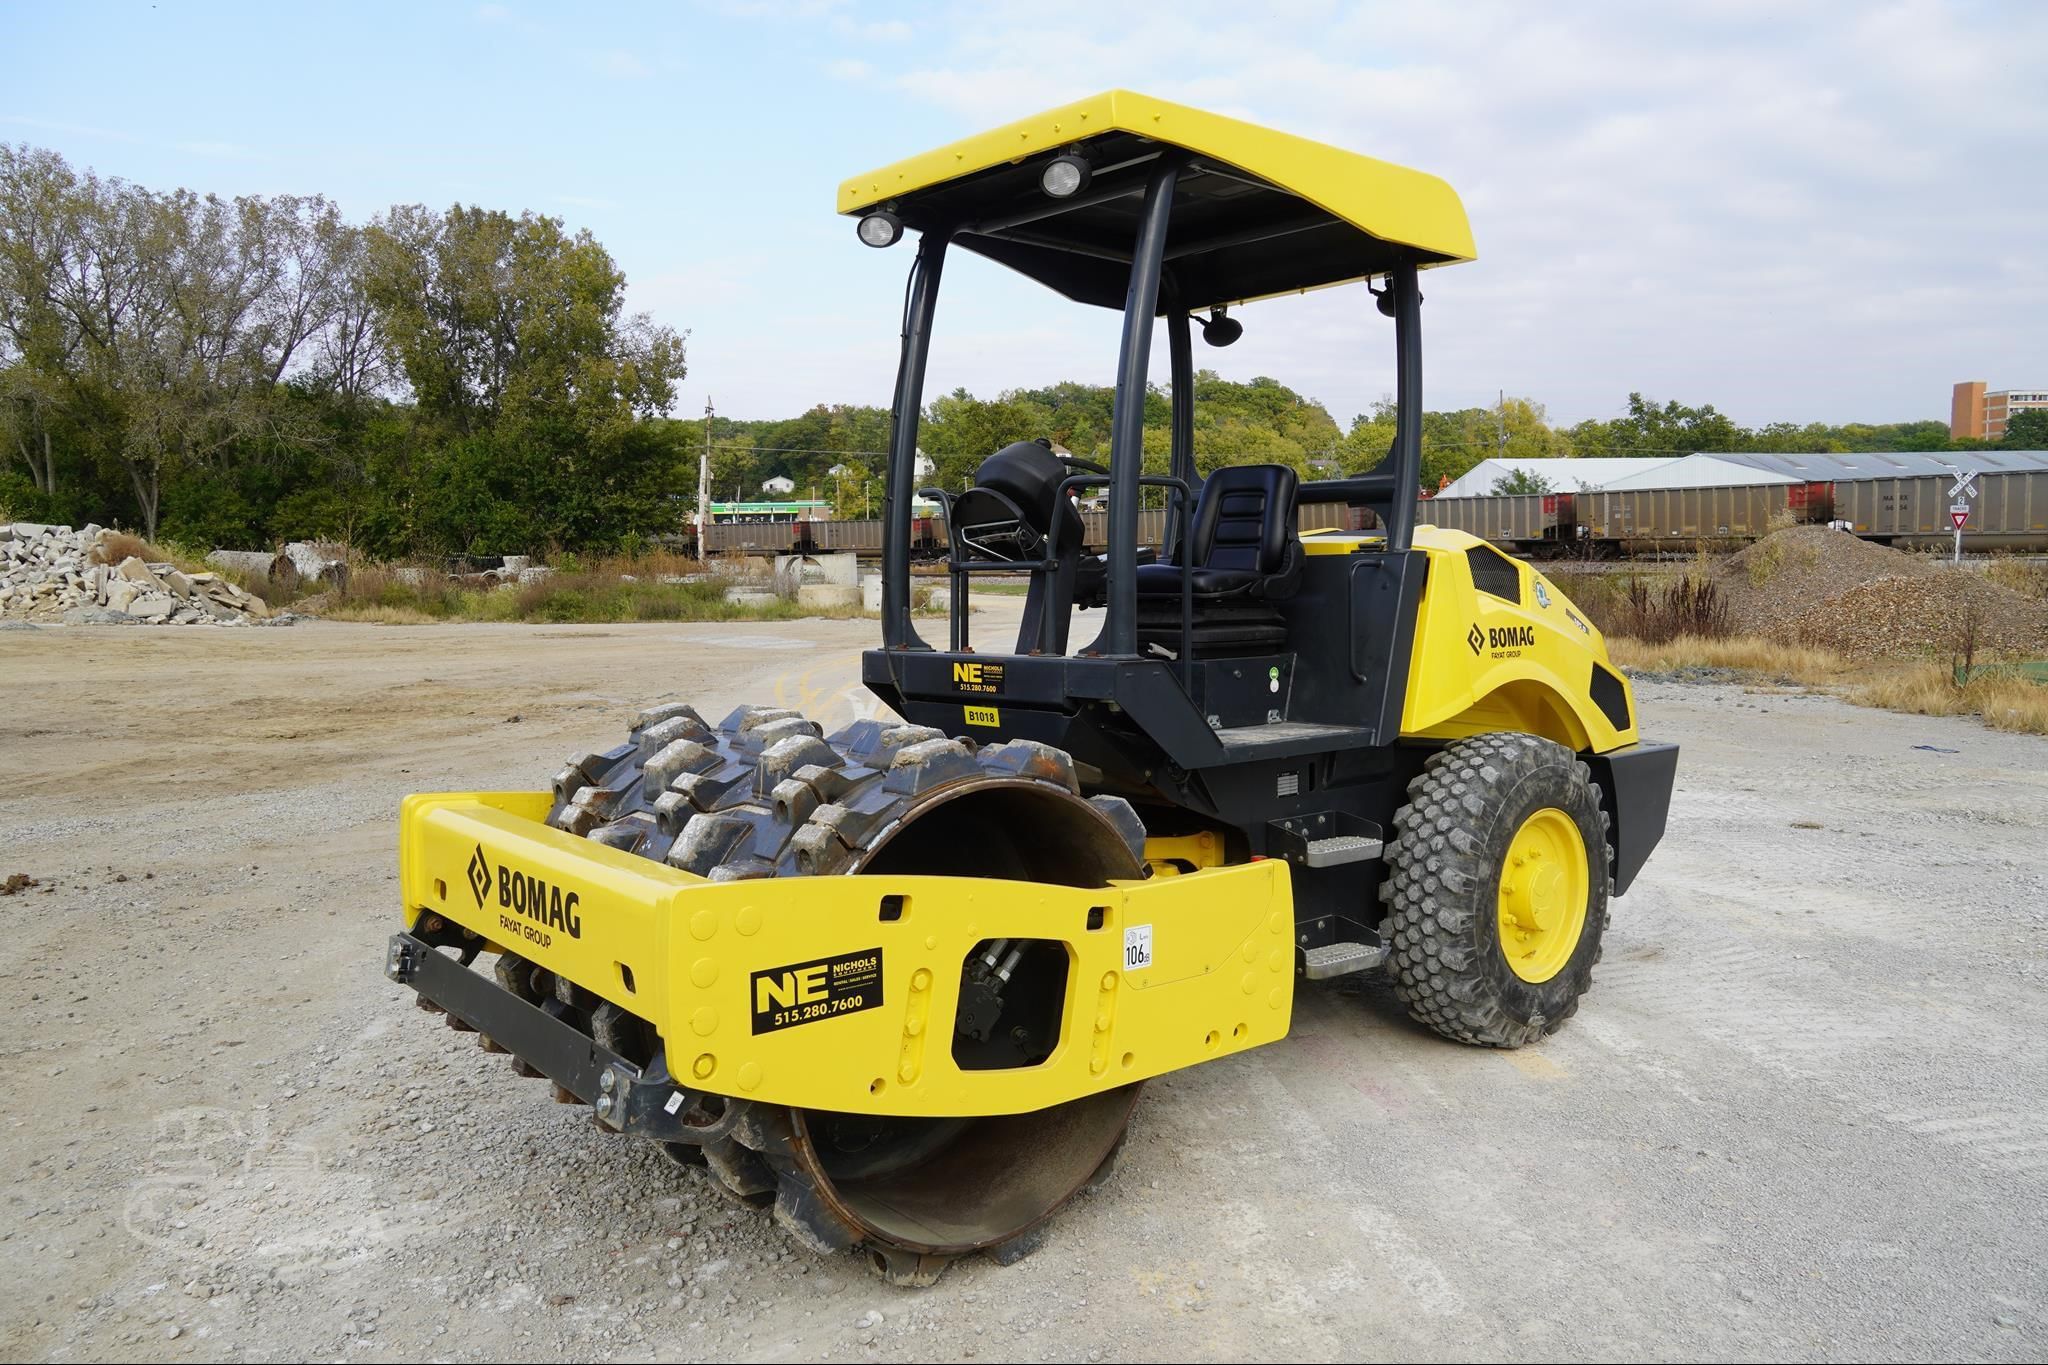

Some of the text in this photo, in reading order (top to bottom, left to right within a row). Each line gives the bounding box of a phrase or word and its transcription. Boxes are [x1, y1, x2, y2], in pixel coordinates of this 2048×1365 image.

[1949, 469, 1977, 497] CROSSING
[1959, 497, 1964, 505] 2
[1489, 626, 1535, 649] BOMAG
[1491, 650, 1521, 659] FAYAT GROUP
[953, 662, 983, 683] NE
[960, 683, 997, 693] 515.280.7600
[969, 711, 995, 723] B1018
[498, 865, 581, 940] BOMAG
[500, 914, 552, 950] FAYAT GROUP
[833, 957, 877, 974] NICHOLS
[1126, 944, 1144, 966] 106
[756, 964, 829, 1014] NE
[774, 995, 863, 1026] 515.280.7600
